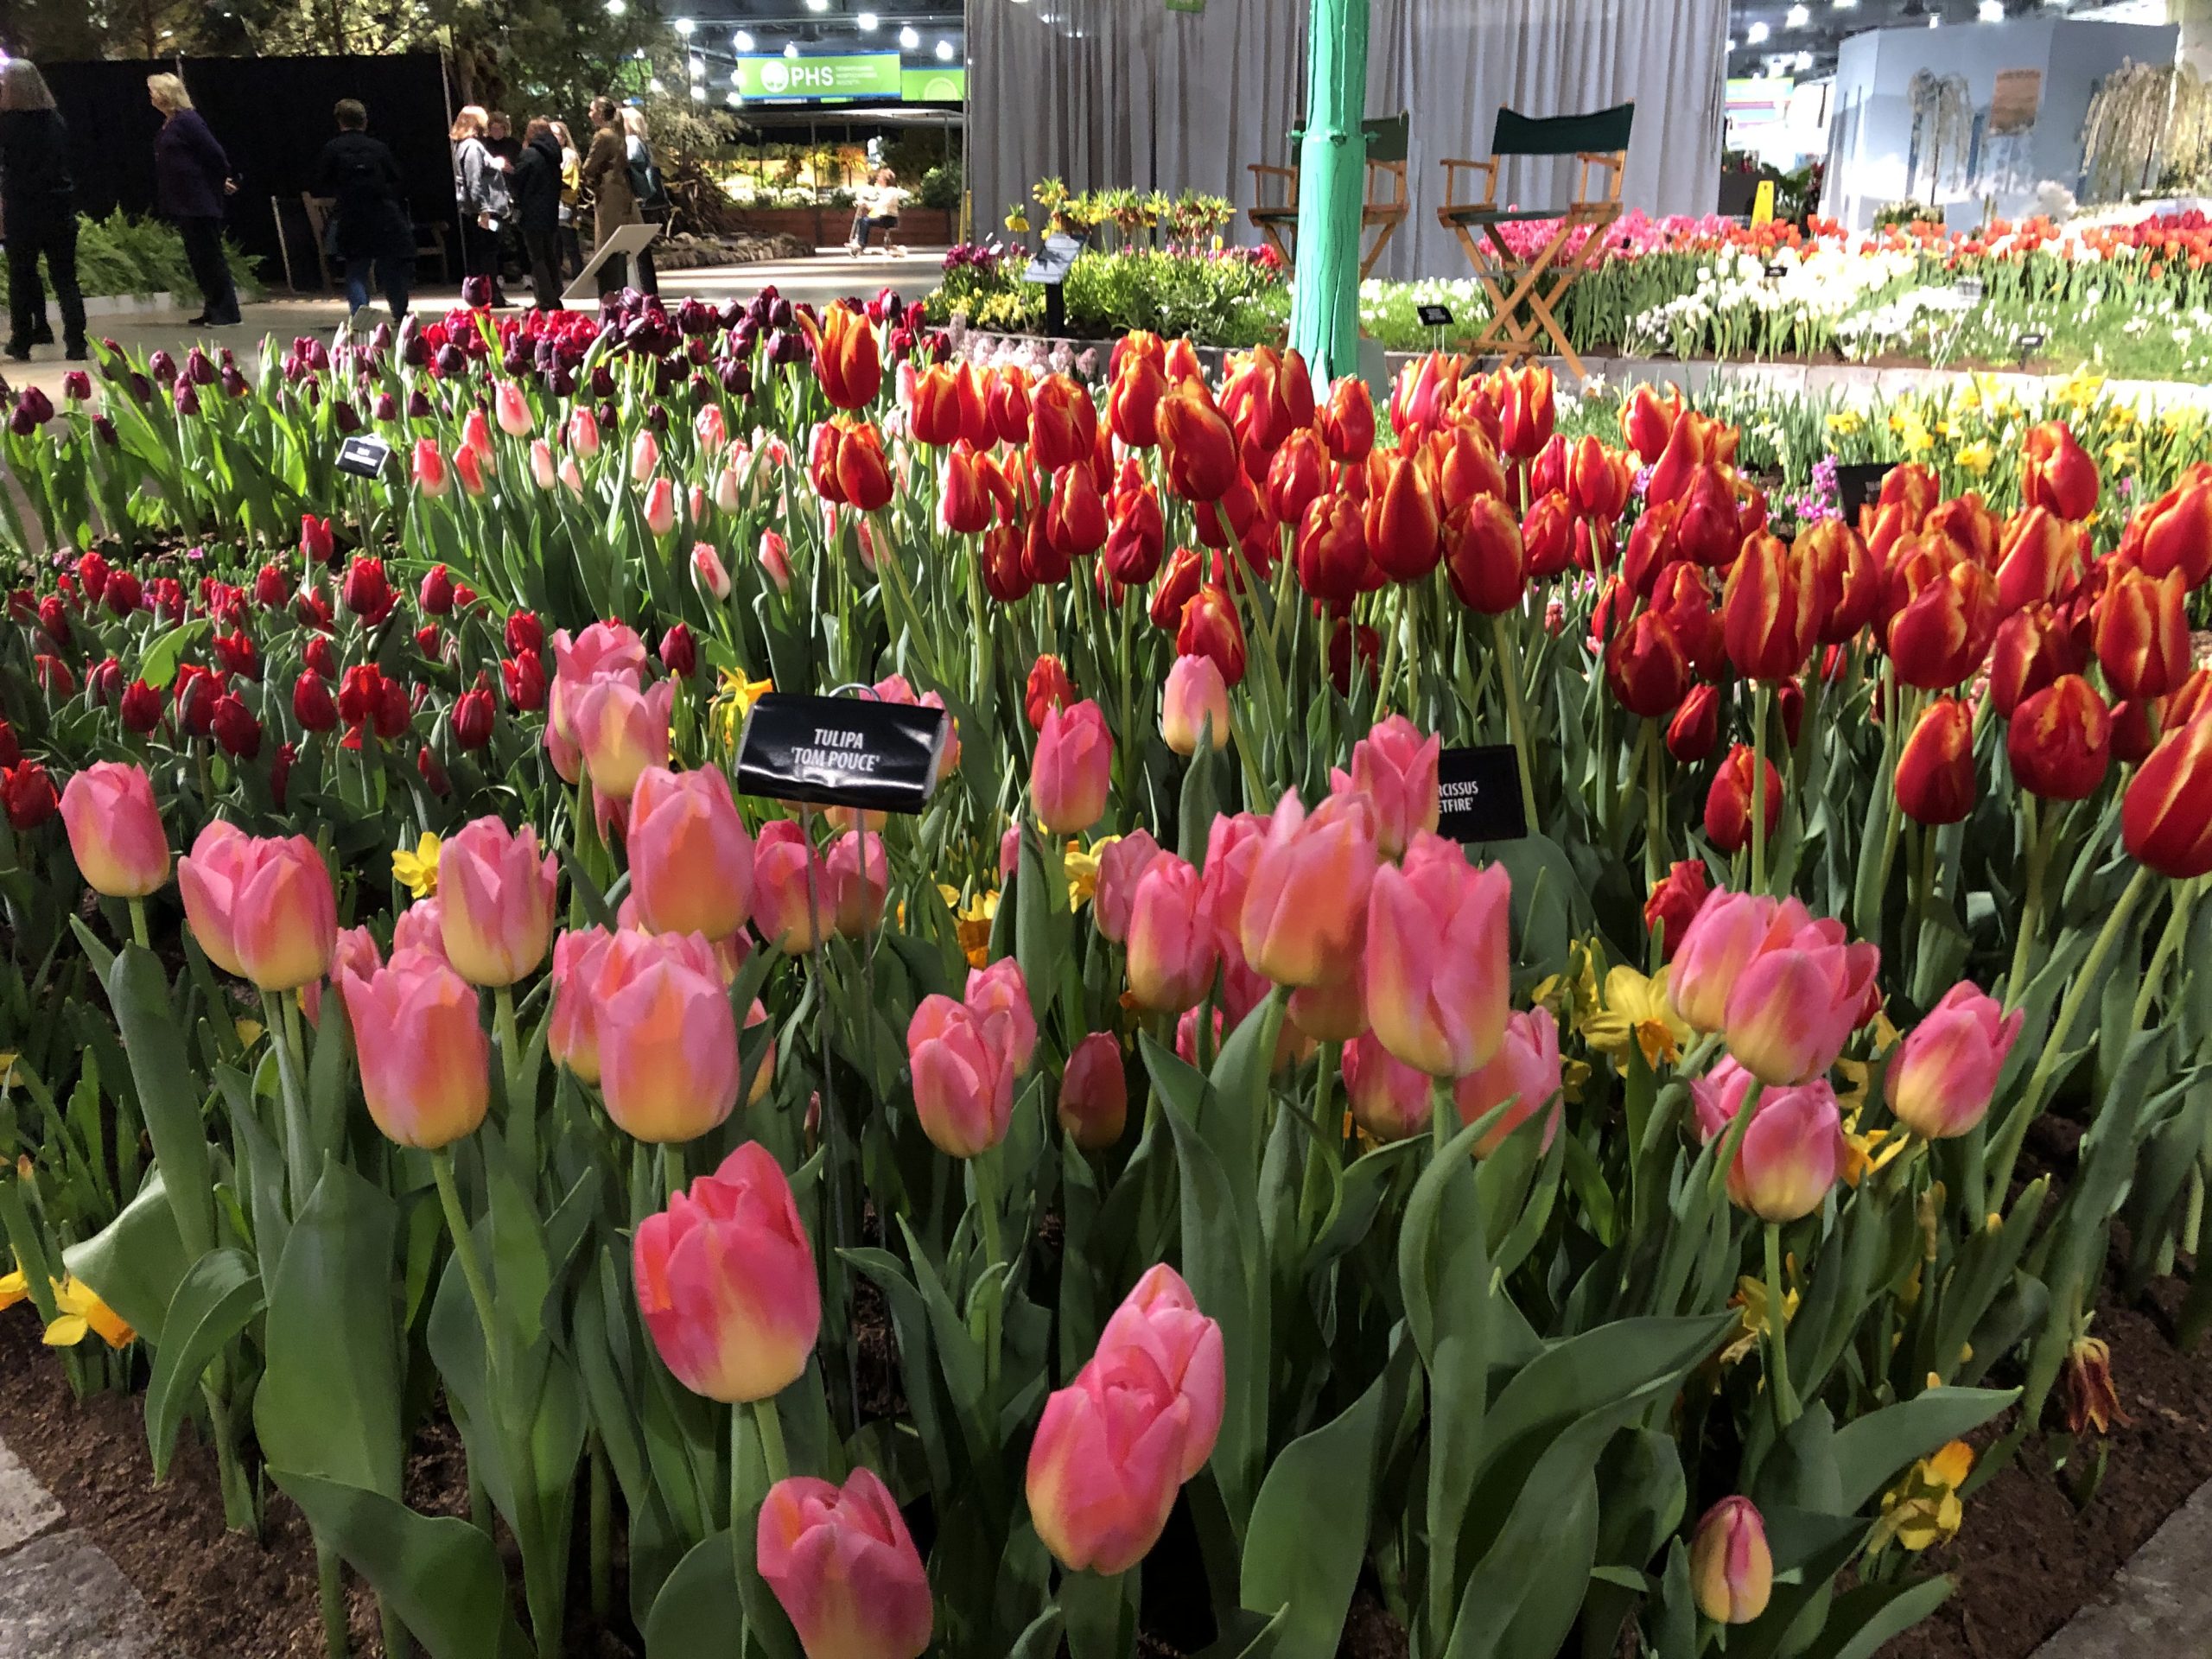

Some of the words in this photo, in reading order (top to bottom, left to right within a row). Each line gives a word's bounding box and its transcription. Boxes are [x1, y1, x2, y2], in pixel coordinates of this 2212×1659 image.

[791, 66, 834, 86] PHS
[814, 728, 863, 749] TULIPA
[791, 747, 825, 766] 'TOM
[828, 751, 880, 772] POUCE'
